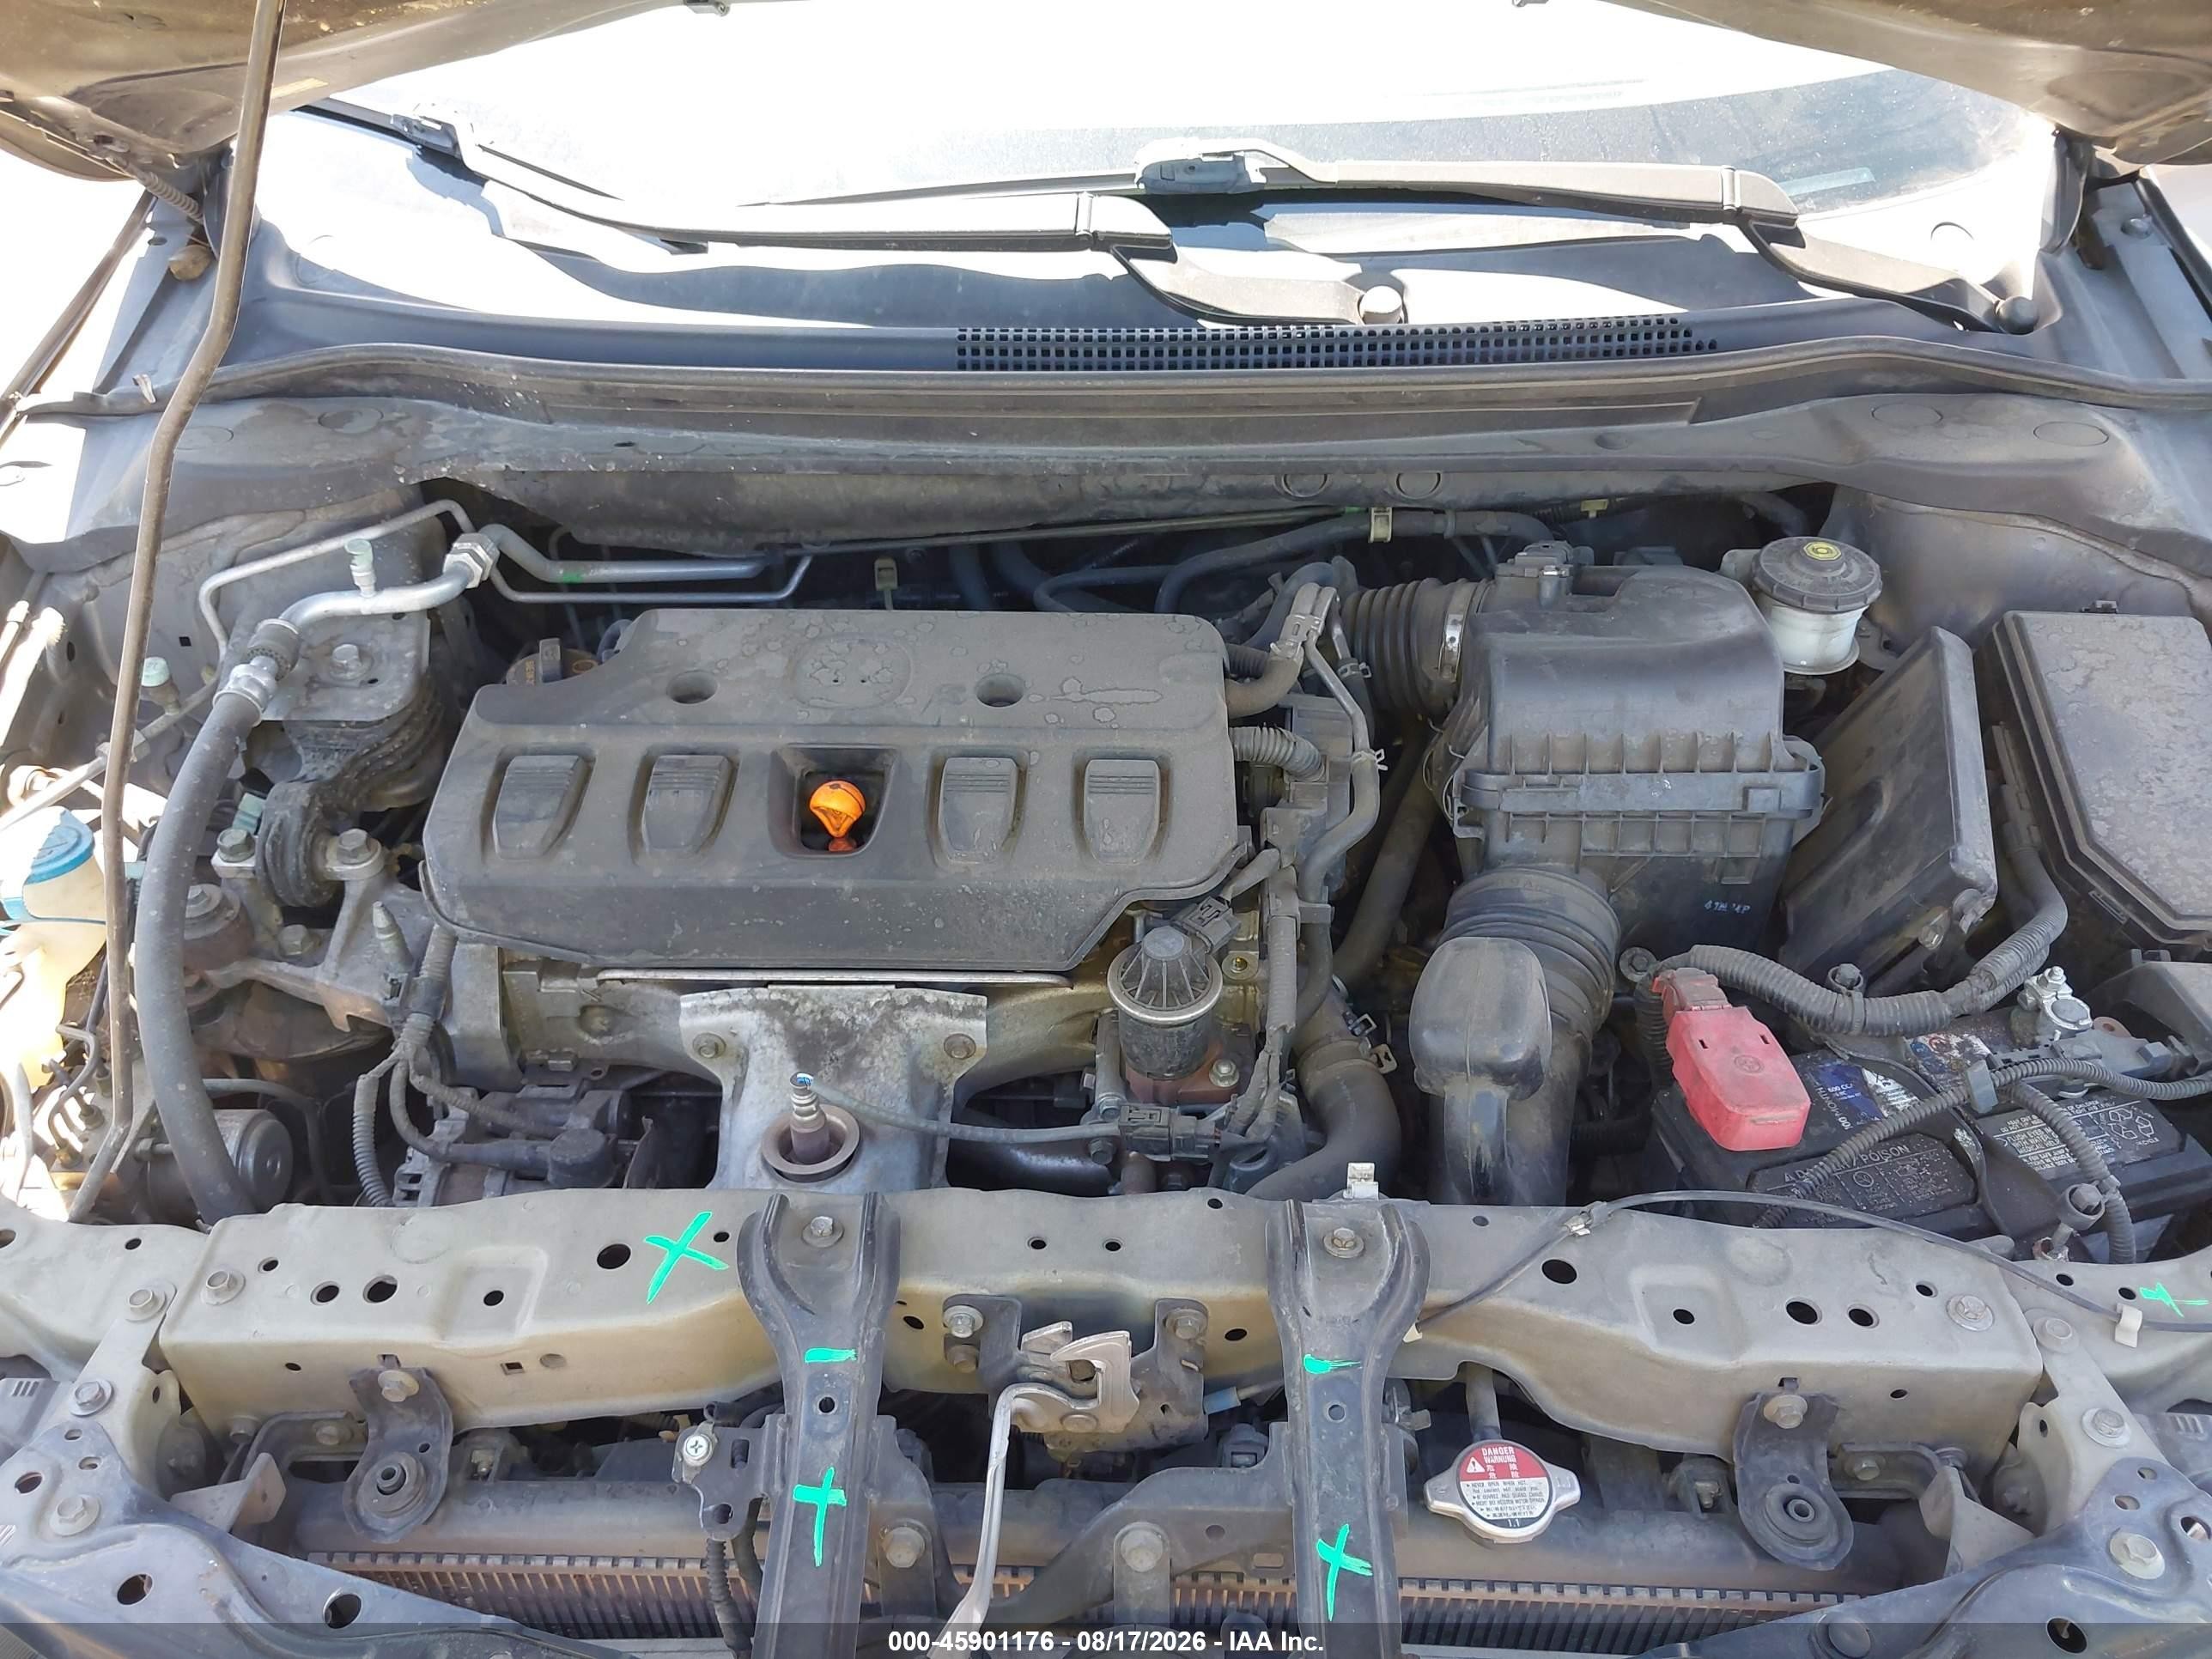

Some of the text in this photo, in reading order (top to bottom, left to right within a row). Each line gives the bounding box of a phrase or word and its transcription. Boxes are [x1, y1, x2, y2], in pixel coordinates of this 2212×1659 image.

[1481, 1446, 1515, 1456] DANGER
[1484, 1455, 1516, 1464] WARNUNG
[1508, 1519, 1520, 1528] 1.1
